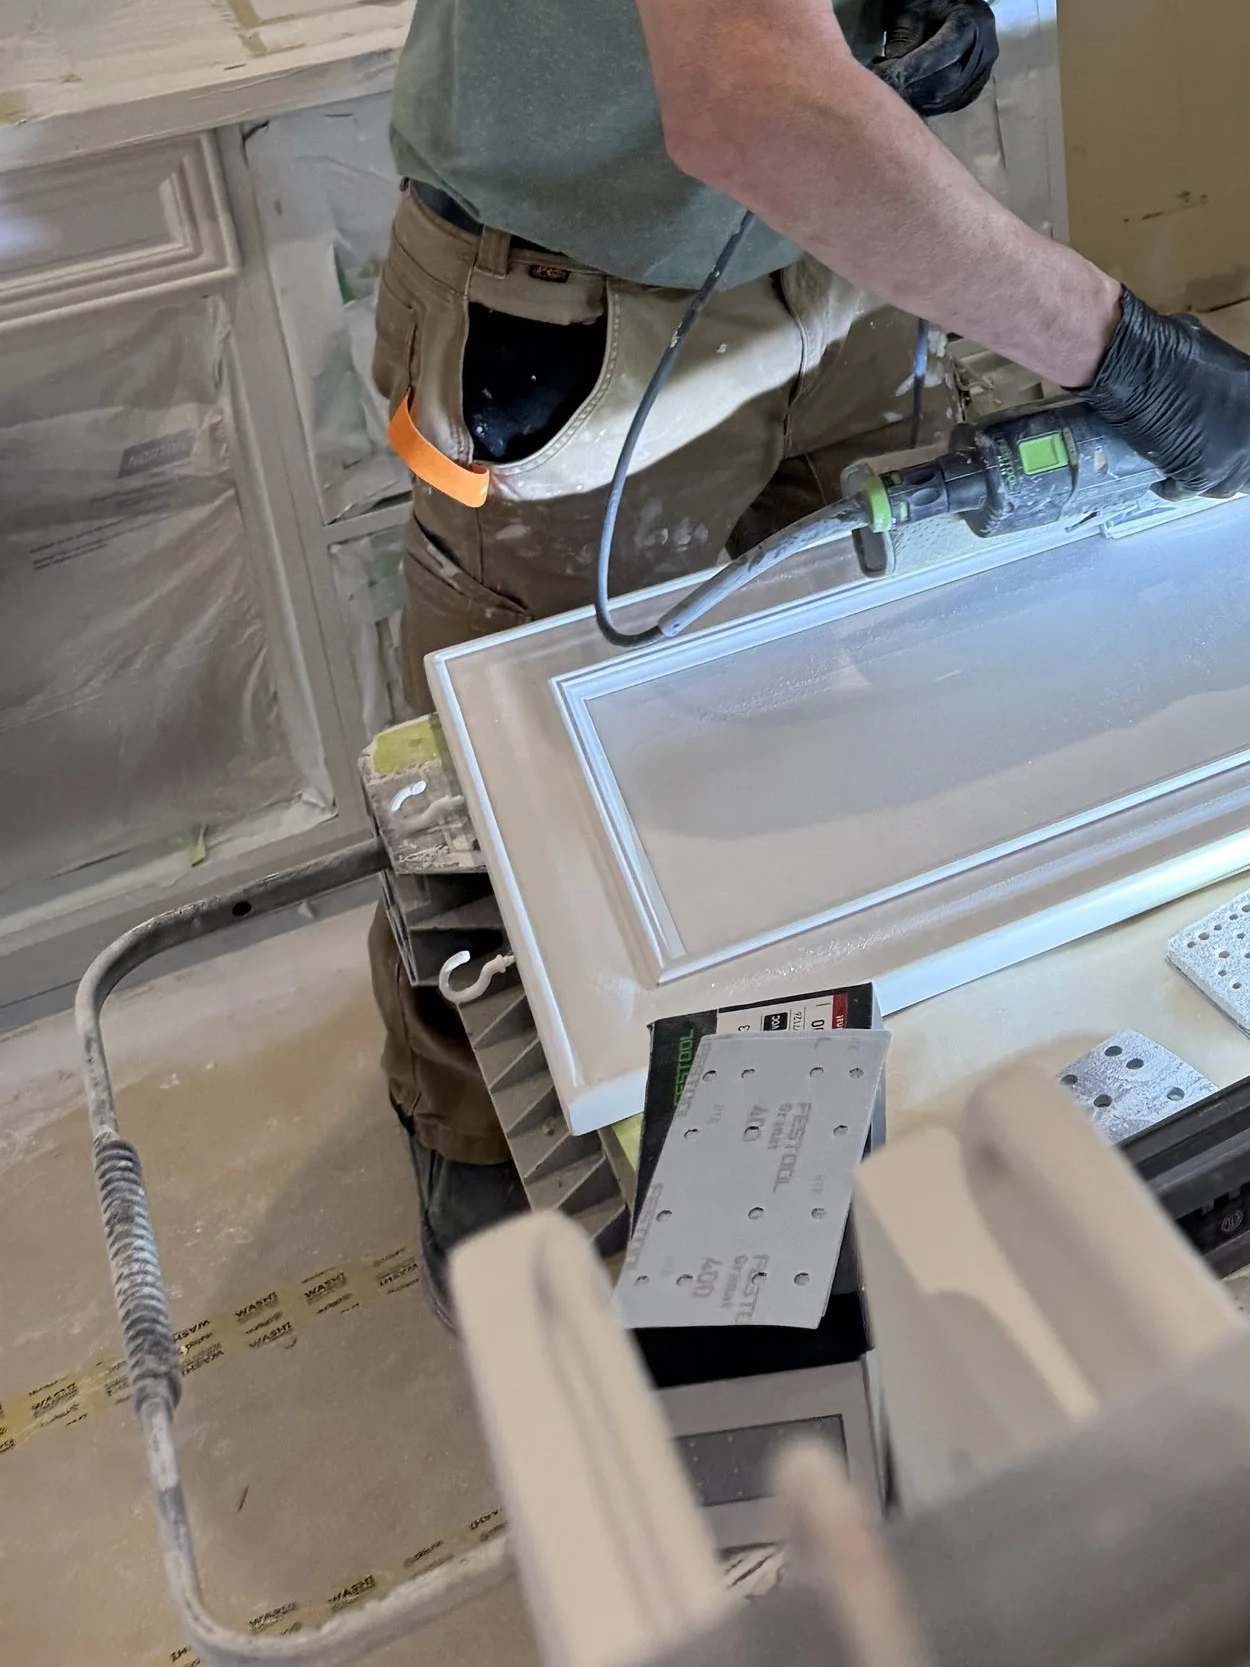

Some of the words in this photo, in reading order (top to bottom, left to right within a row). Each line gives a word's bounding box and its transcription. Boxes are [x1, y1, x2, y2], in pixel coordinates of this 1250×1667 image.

[772, 1102, 812, 1193] FESTOOL
[692, 1256, 723, 1299] 400
[235, 1291, 278, 1319] WASHI
[249, 1321, 292, 1348] WASHI
